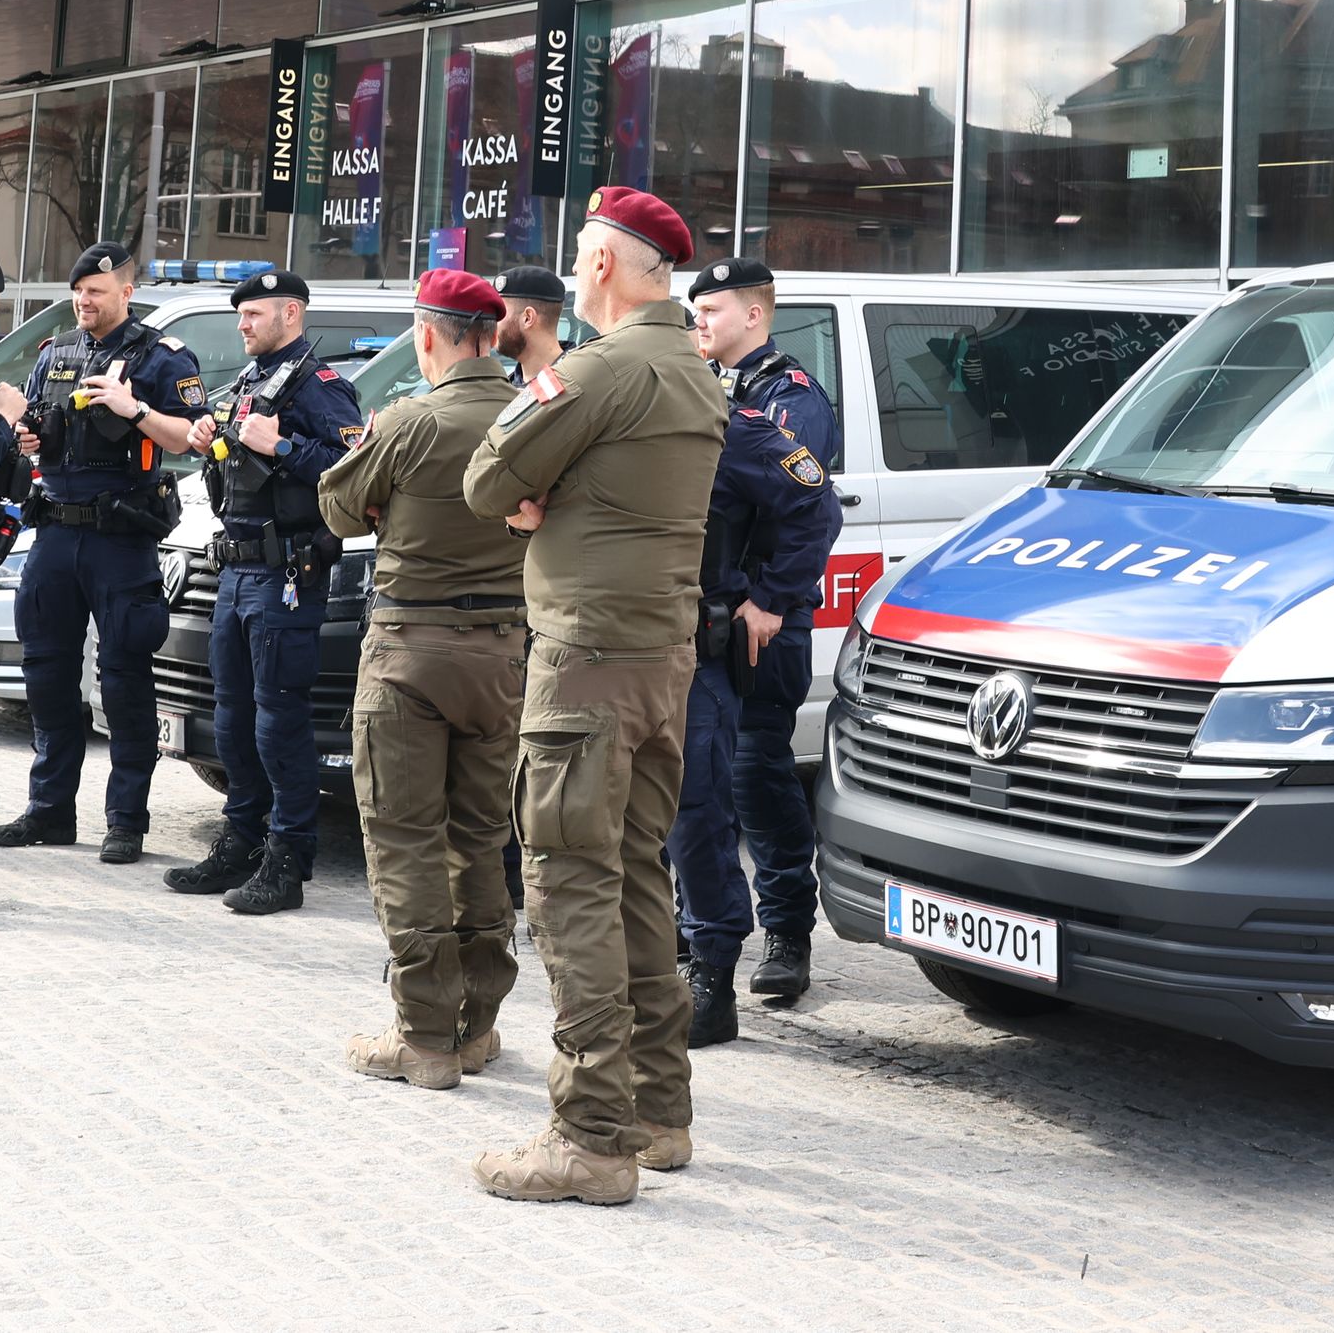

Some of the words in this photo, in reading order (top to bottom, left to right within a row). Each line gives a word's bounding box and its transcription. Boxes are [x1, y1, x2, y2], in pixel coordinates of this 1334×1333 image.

[541, 28, 567, 163] EINGANG
[272, 68, 297, 183] EINGANG
[332, 146, 380, 176] KASSA
[461, 133, 518, 167] KASSA
[322, 197, 369, 226] HALLE
[372, 197, 382, 225] F
[461, 179, 509, 221] CAFÉ
[47, 370, 76, 381] POLIZEI
[785, 449, 809, 468] POLIZEI
[966, 537, 1270, 592] POLIZEI
[892, 916, 900, 928] A
[911, 898, 941, 938] BP
[961, 912, 1042, 966] 90701
